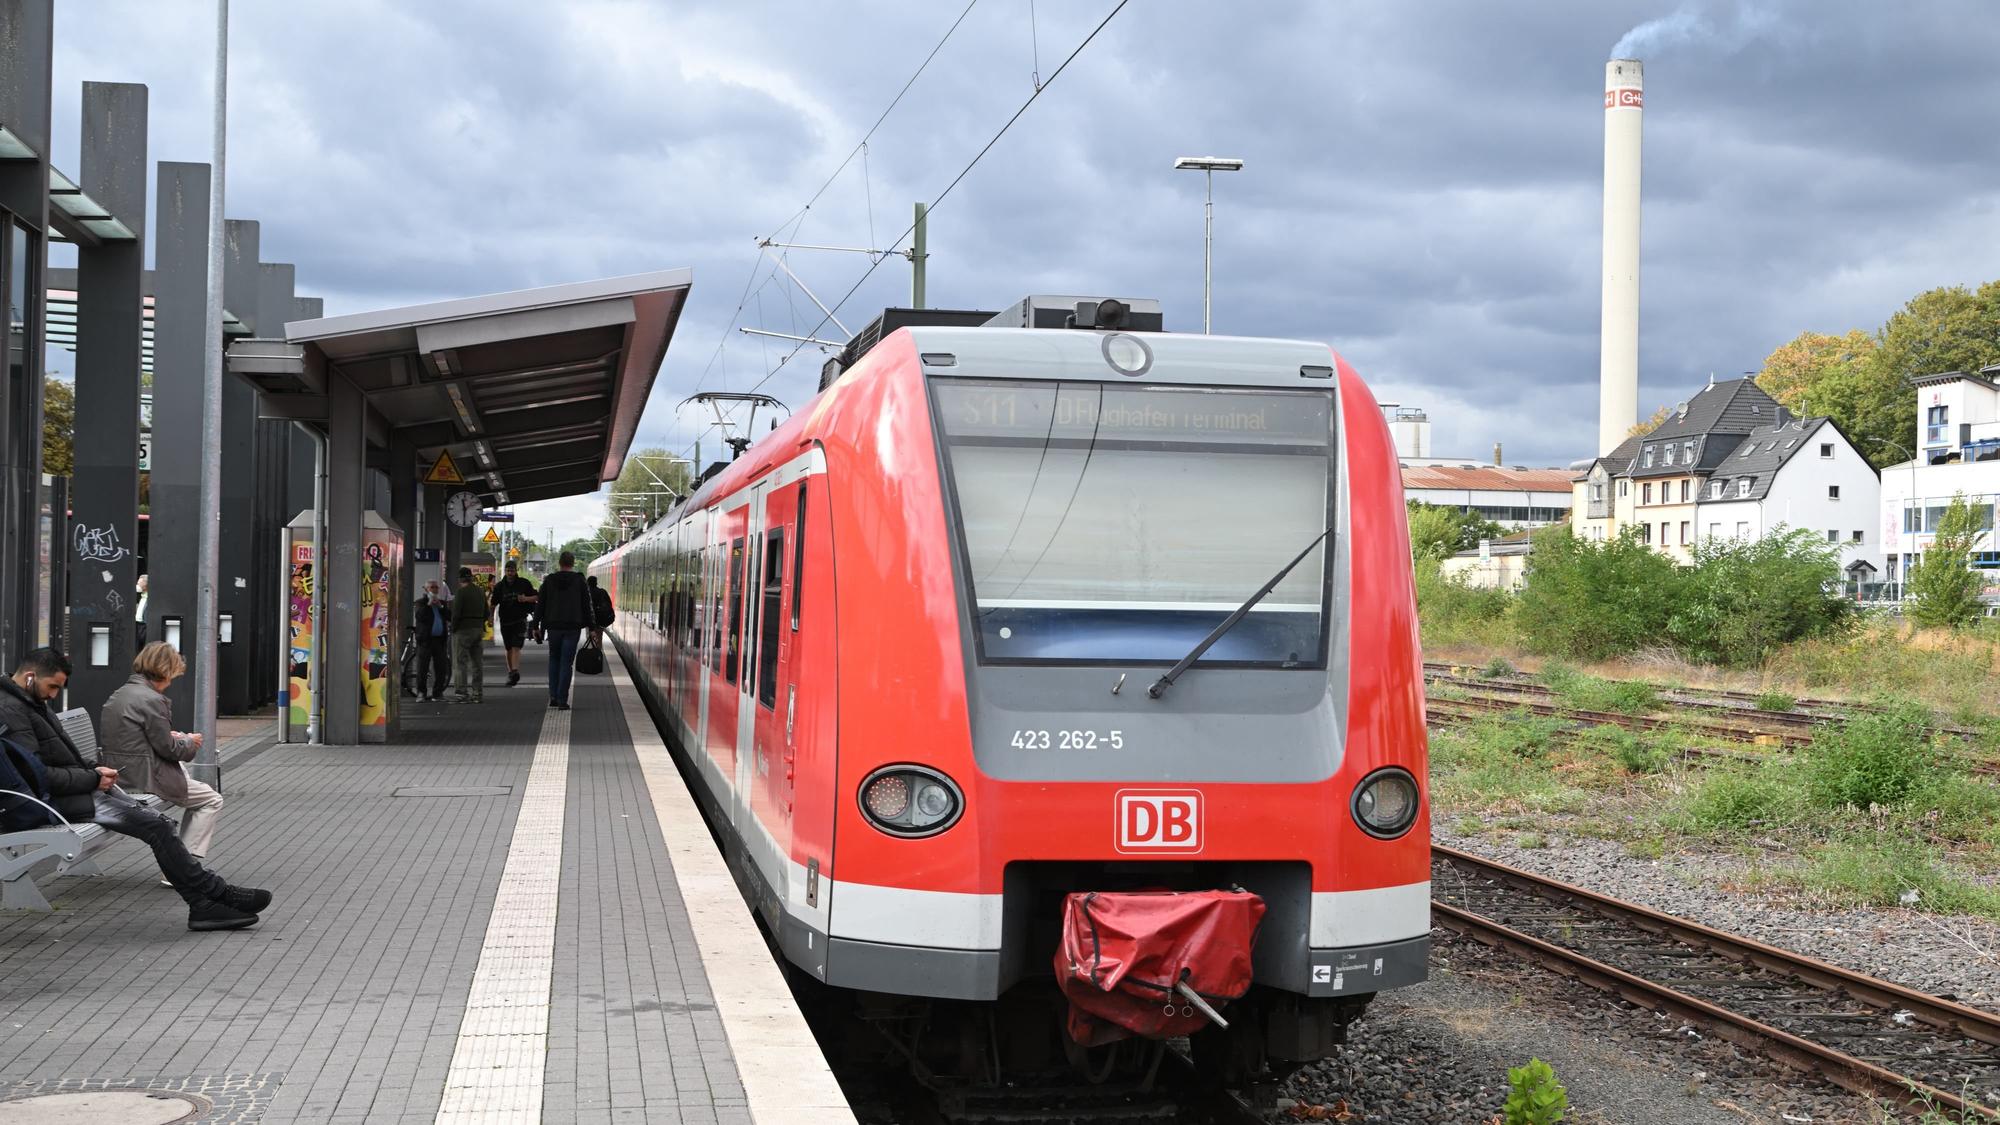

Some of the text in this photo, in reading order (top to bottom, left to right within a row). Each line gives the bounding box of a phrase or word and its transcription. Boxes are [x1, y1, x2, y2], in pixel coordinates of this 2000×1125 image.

[1011, 730, 1123, 749] 423 262-5
[1126, 799, 1194, 843] DB
